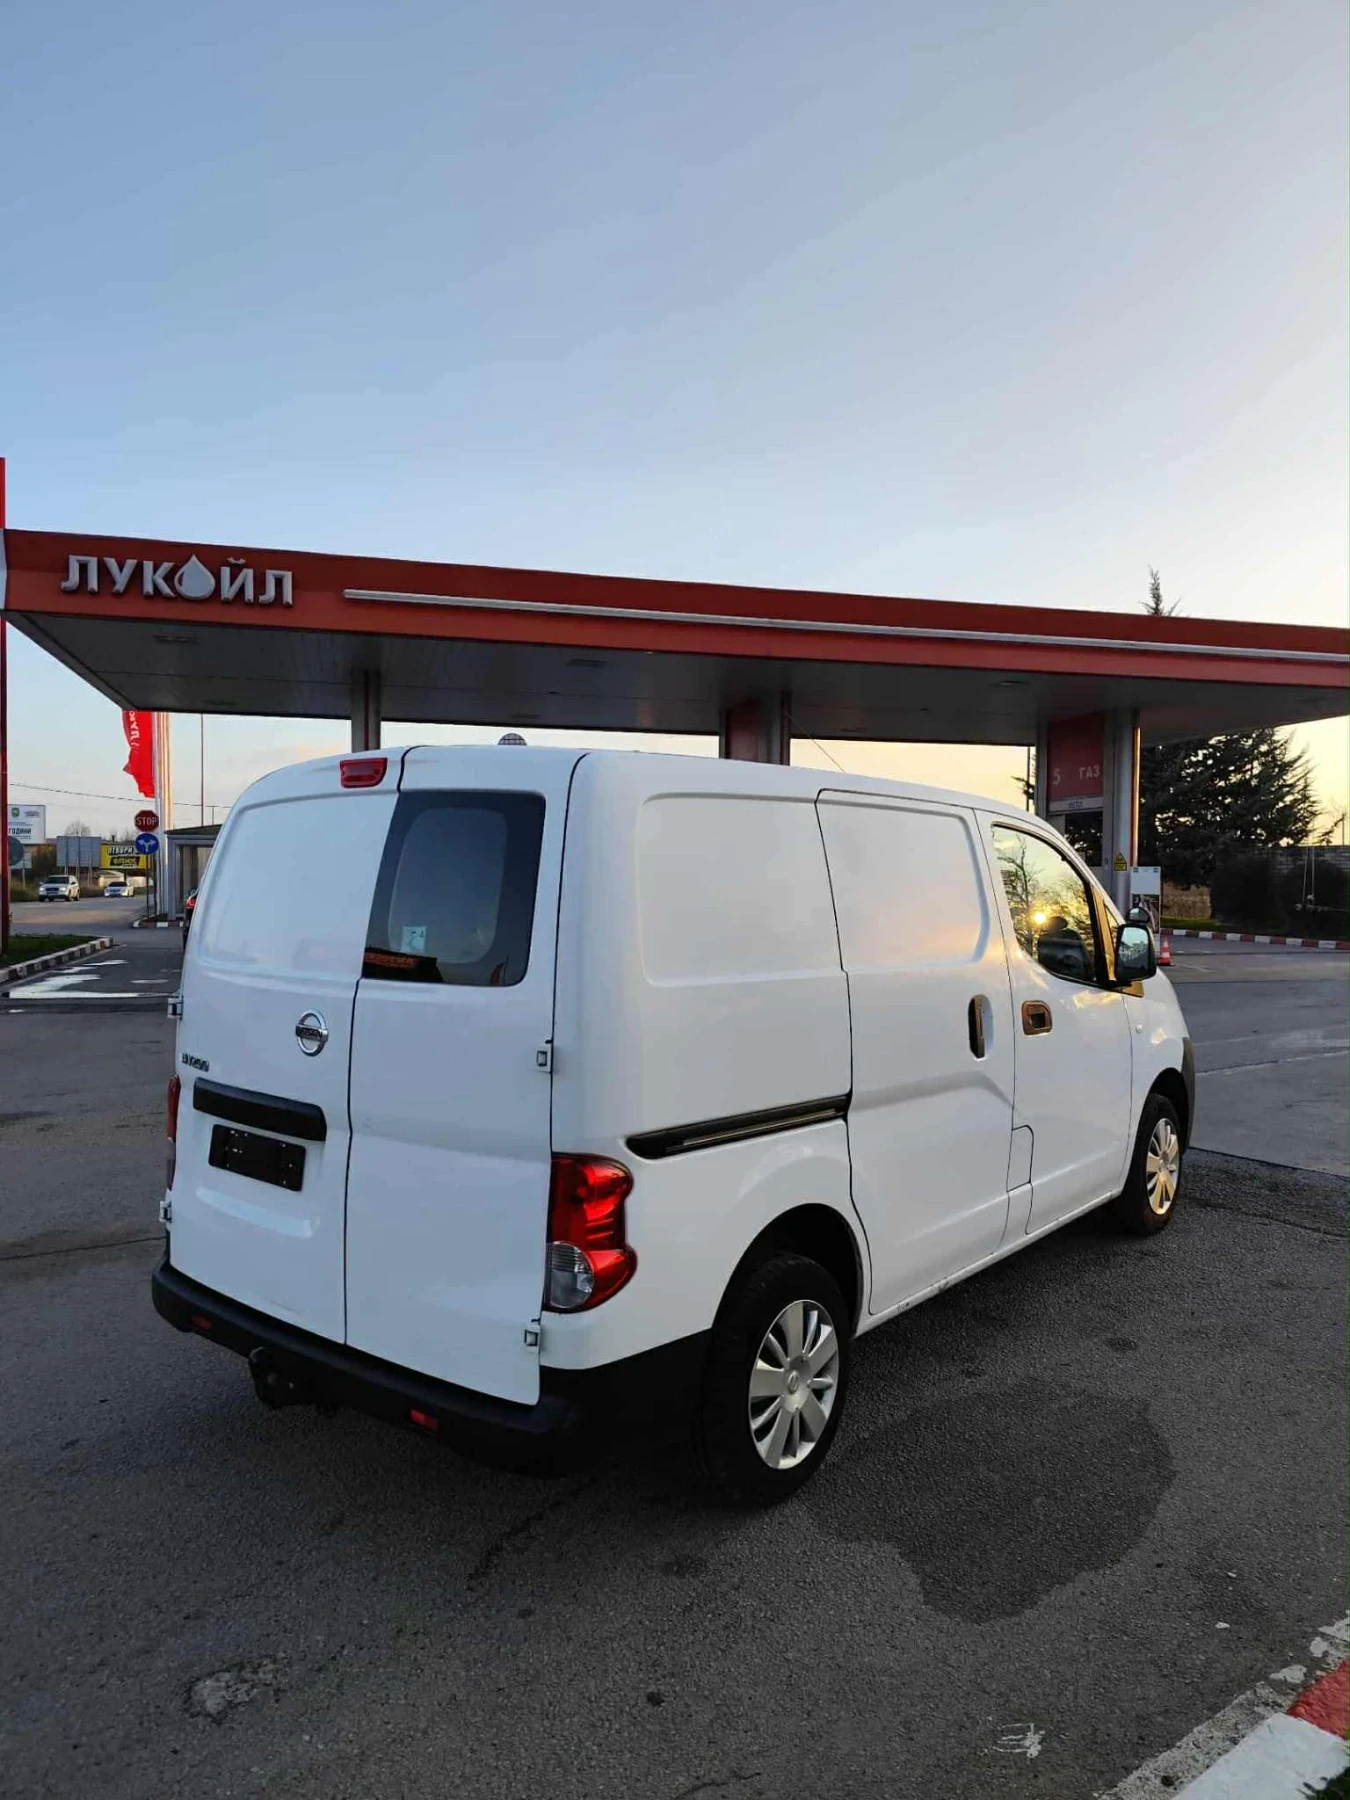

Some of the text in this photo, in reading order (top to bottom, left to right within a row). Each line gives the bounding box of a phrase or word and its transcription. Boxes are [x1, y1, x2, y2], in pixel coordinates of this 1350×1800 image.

[1052, 764, 1100, 786] 5 ГАЗ
[136, 816, 157, 826] STOP
